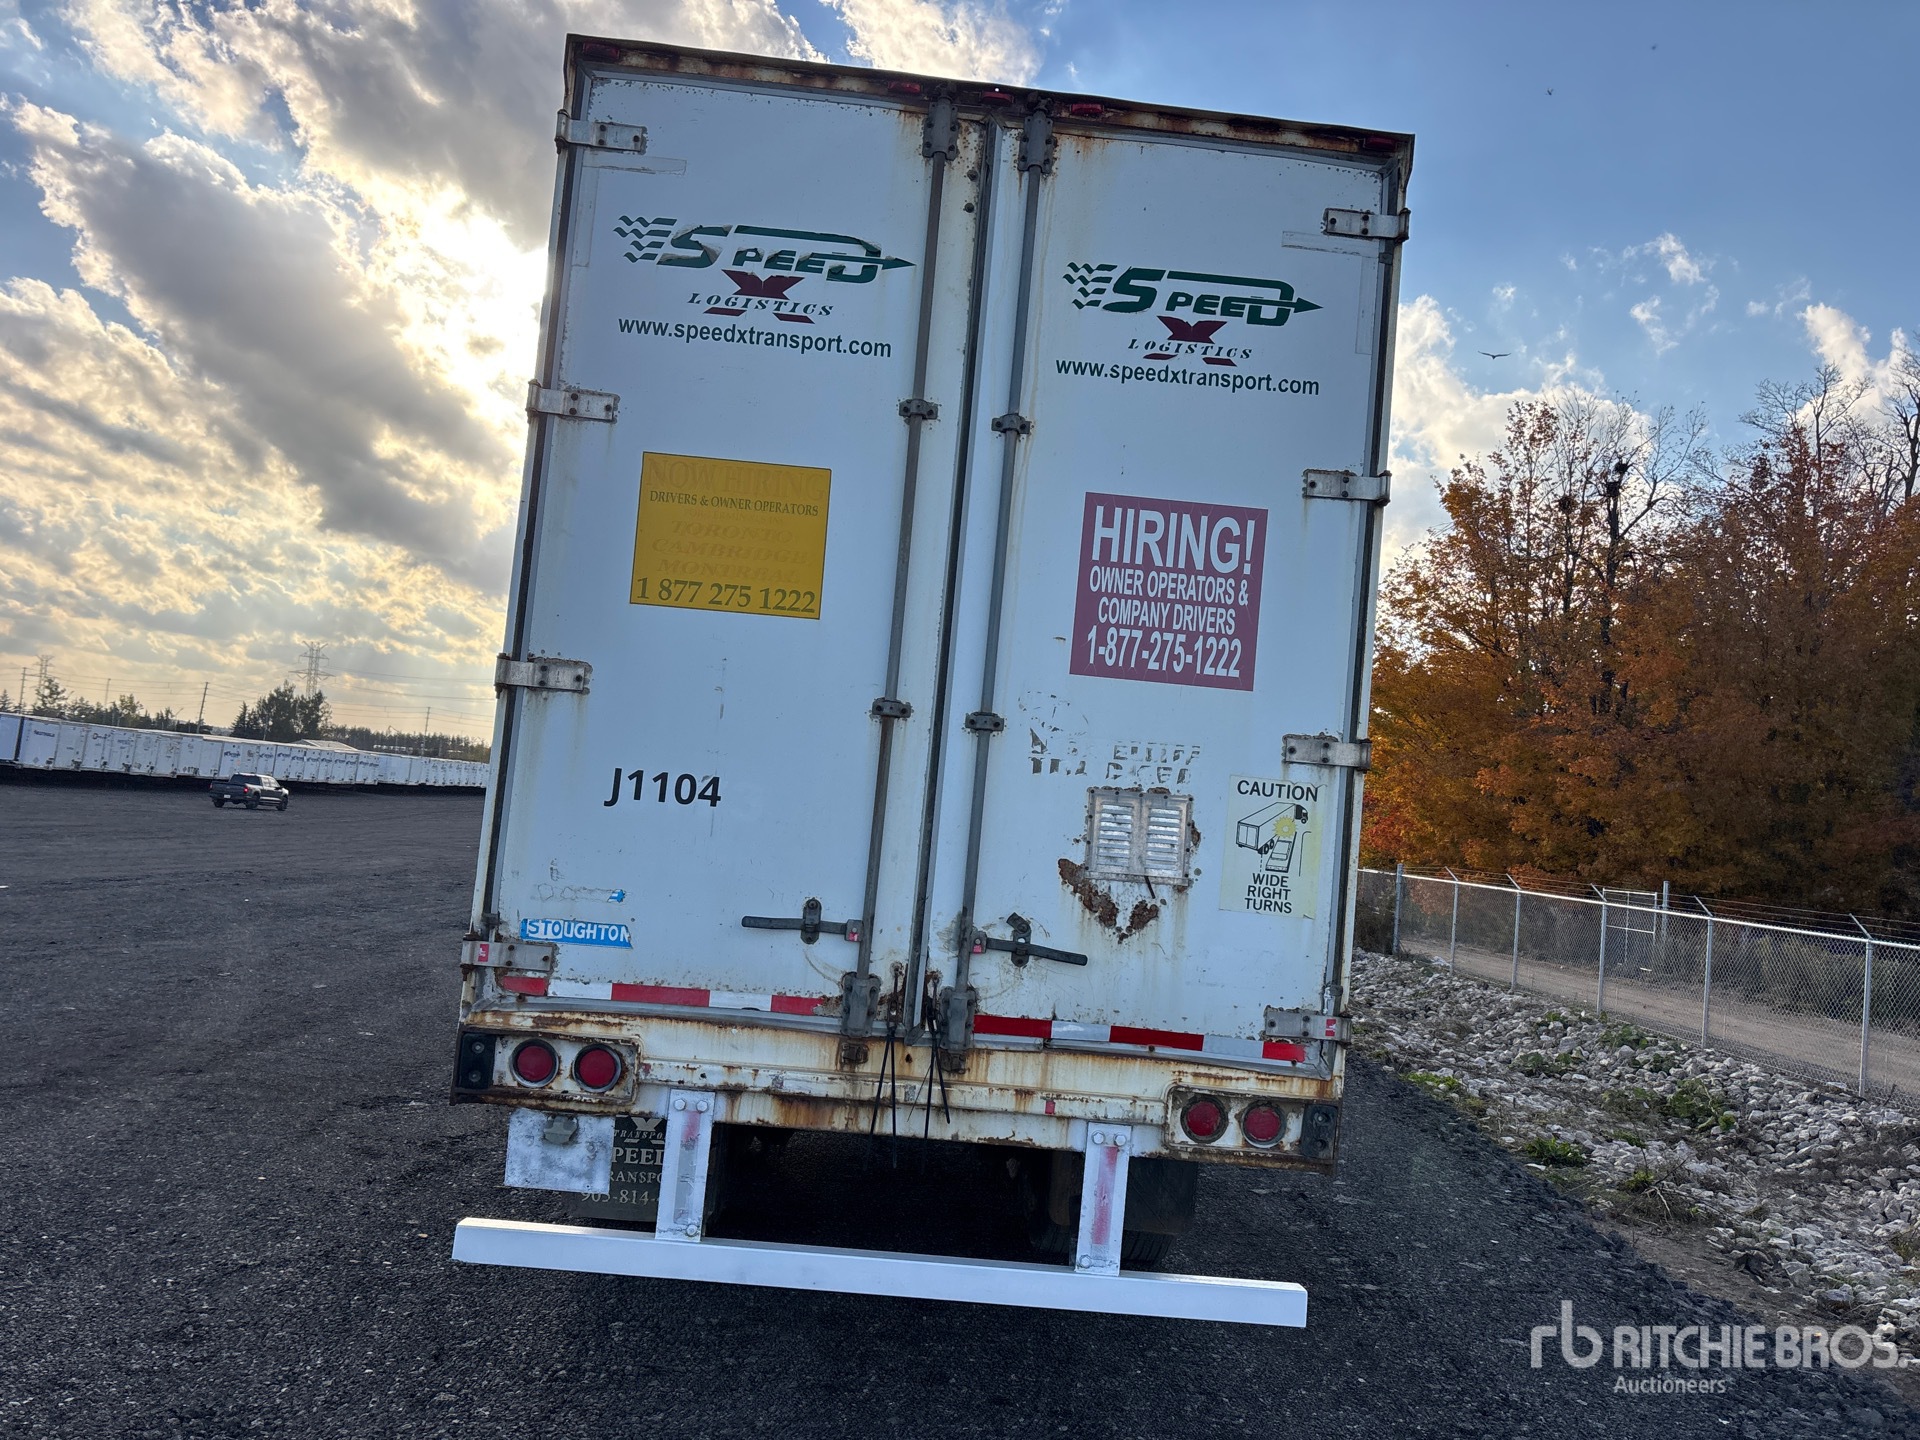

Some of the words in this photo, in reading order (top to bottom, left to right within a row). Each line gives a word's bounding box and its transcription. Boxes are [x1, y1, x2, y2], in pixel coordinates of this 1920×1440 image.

[687, 292, 834, 317] LOGISTICS
[1102, 266, 1296, 327] SPEED
[618, 317, 892, 358] www.speedxtransport.com
[1127, 338, 1253, 360] LOGISTICS
[1055, 359, 1320, 396] www.speedxtransport.com
[650, 490, 698, 506] DRIVERS
[700, 496, 709, 507] &
[711, 496, 753, 511] OWNER
[754, 500, 819, 517] OPERATORS
[1091, 505, 1256, 575] HIRING!
[637, 577, 650, 599] 1
[658, 578, 704, 603] 877
[708, 582, 752, 608] 275
[759, 587, 816, 614] 1222
[1089, 565, 1144, 597] OWNER
[1147, 571, 1236, 606] OPERATORS
[1238, 579, 1249, 606] &
[1098, 596, 1171, 629] COMPANY
[1172, 603, 1236, 636] DRIVERS
[1087, 624, 1242, 678] 1-877-275-1222
[603, 767, 722, 808] J1104
[1237, 779, 1319, 802] CAUTION
[1247, 885, 1292, 901] RIGHT
[1252, 872, 1289, 888] WIDE
[1244, 897, 1293, 914] TURNS
[527, 918, 631, 943] STOUGHTON
[614, 1129, 666, 1140] TRANSPO
